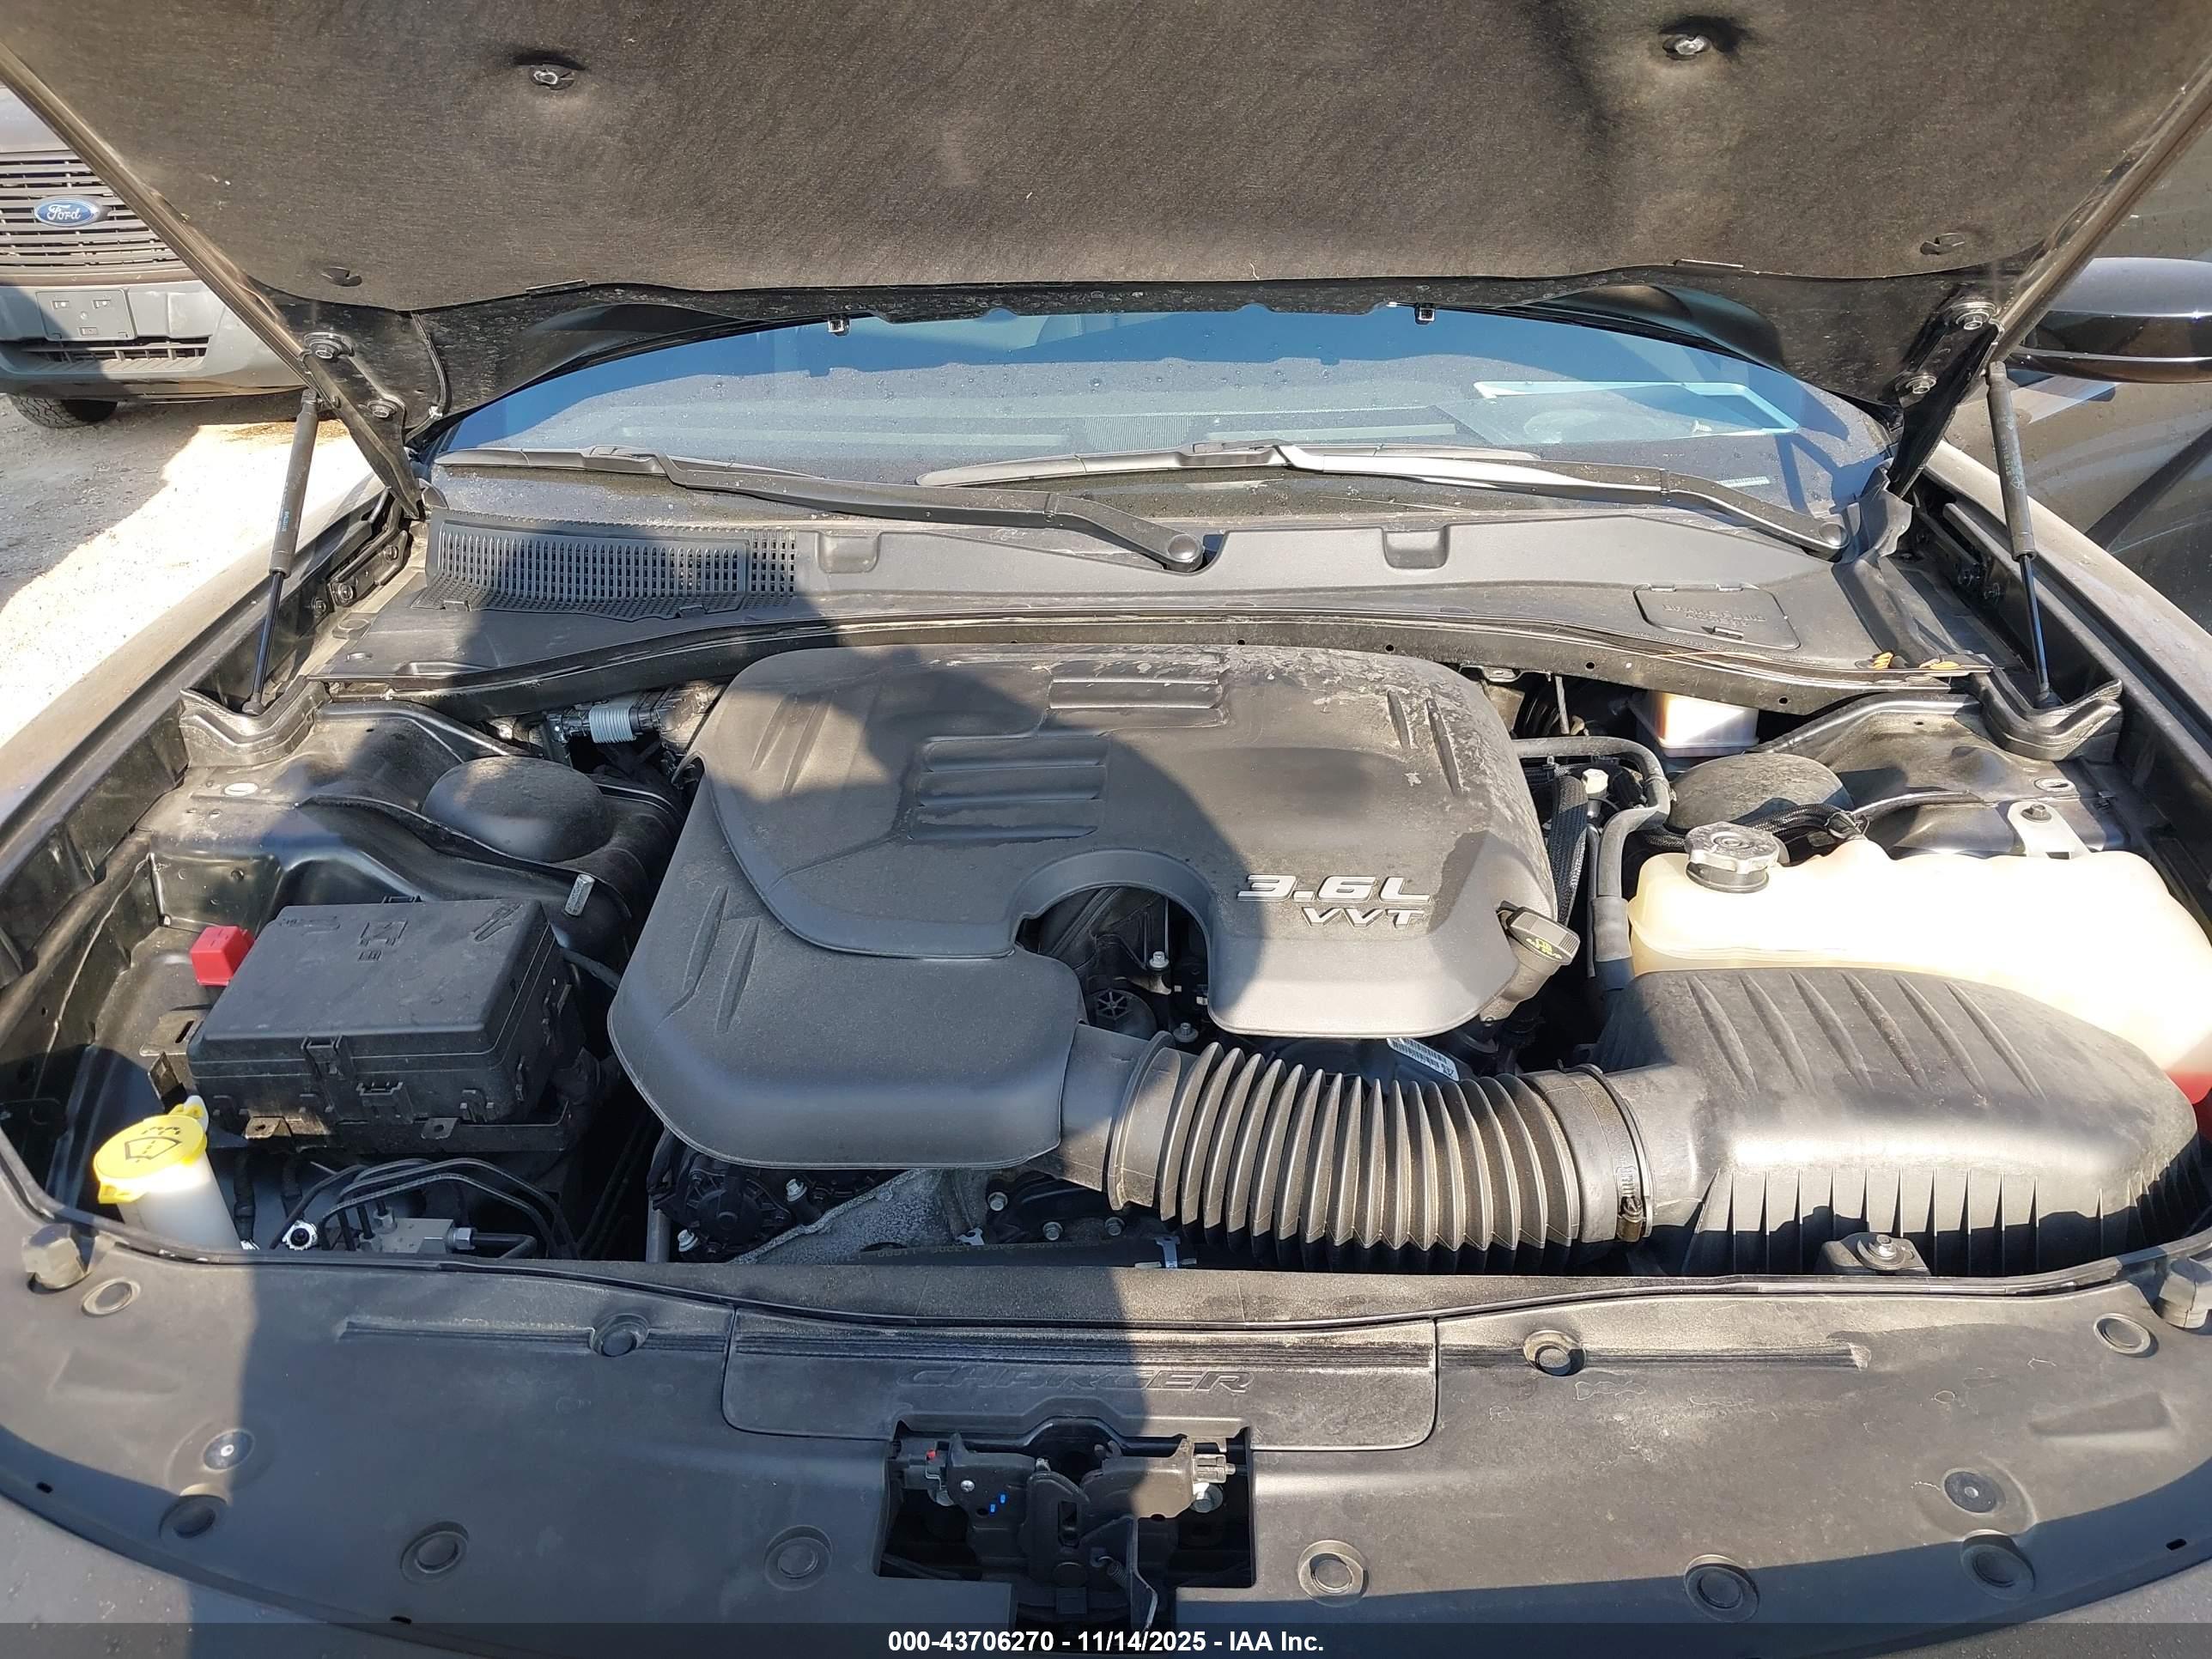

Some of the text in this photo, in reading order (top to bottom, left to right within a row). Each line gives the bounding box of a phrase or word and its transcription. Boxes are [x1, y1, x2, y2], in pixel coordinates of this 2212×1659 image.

[46, 204, 82, 222] Ford
[1237, 874, 1431, 902] 3.6L
[1301, 907, 1425, 929] VVT
